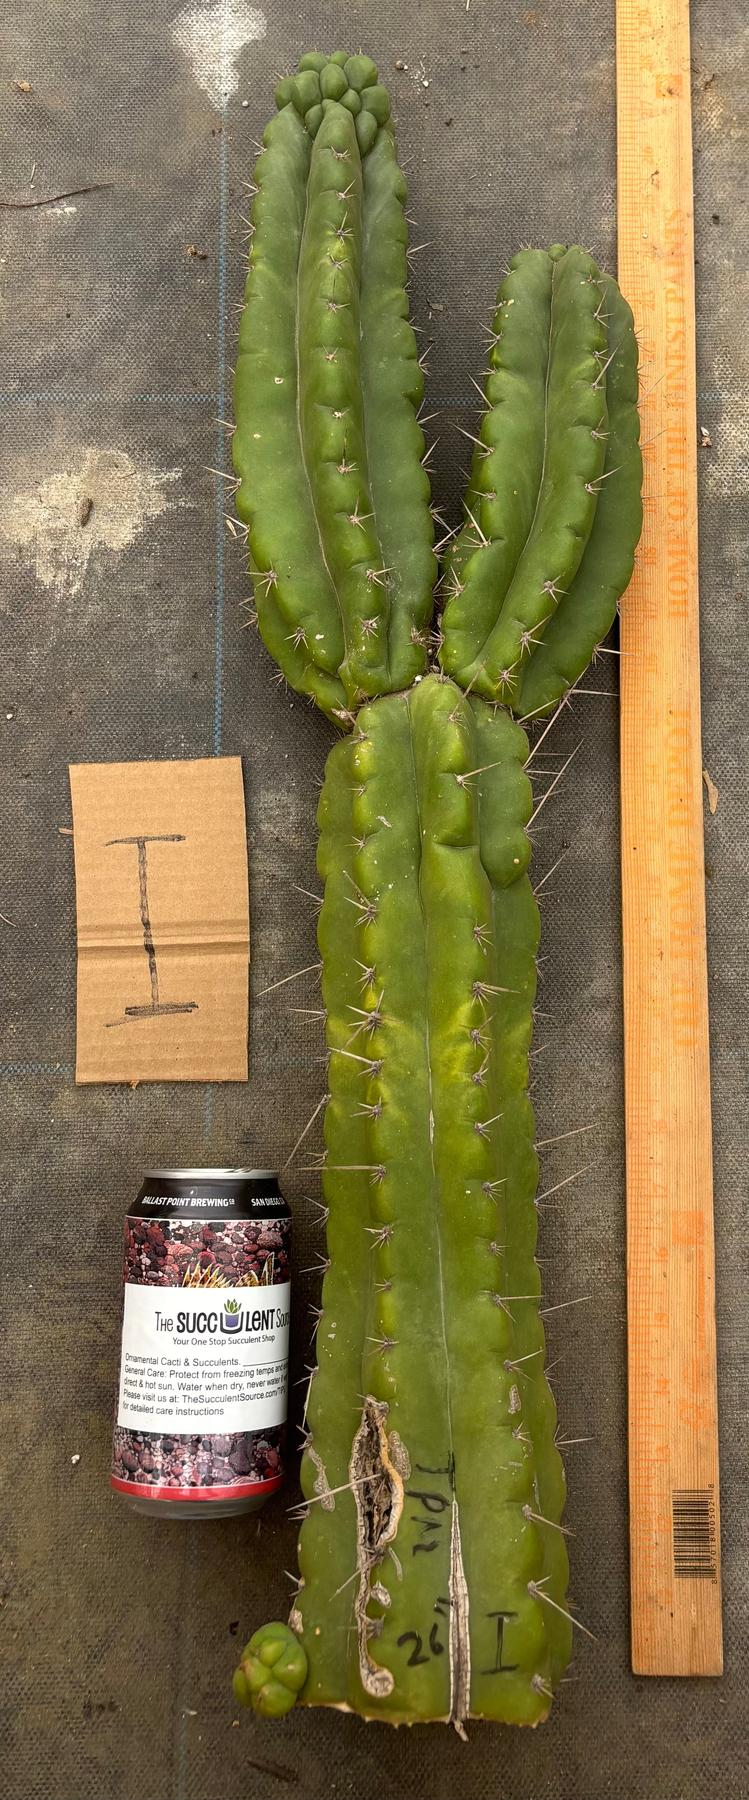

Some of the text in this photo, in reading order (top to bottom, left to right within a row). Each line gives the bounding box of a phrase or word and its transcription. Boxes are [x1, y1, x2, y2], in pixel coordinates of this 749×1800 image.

[663, 208, 686, 304] PAINTS
[666, 483, 688, 522] OF
[667, 531, 689, 618] HOME
[668, 840, 697, 960] HOME
[142, 1196, 168, 1205] BALLAST
[167, 1197, 191, 1206] POINT
[190, 1198, 229, 1207] BREWING
[250, 1197, 265, 1207] SAN
[265, 1197, 280, 1206] DIEGO
[172, 1337, 189, 1345] Your
[209, 1338, 227, 1346] Stop
[228, 1336, 261, 1345] Succulent
[262, 1335, 276, 1343] Shop
[125, 1352, 241, 1366] Ornamental Cacti & Succulents.
[125, 1364, 145, 1376] General
[147, 1368, 167, 1378] Care:
[169, 1369, 199, 1379] Protect
[201, 1370, 221, 1378] from
[223, 1369, 254, 1378] freezing
[256, 1366, 274, 1376] temps
[124, 1377, 137, 1387] direct
[139, 1379, 143, 1388] &
[145, 1381, 156, 1389] hot
[158, 1383, 175, 1391] sun.
[177, 1382, 202, 1391] Water
[205, 1382, 228, 1391] when
[230, 1382, 245, 1392] dry,
[246, 1379, 266, 1389] never
[267, 1376, 280, 1386] water
[123, 1388, 141, 1400] Please
[142, 1392, 156, 1401] visit
[169, 1395, 180, 1403] at:
[130, 1403, 154, 1414] detailed
[155, 1407, 173, 1415] care
[175, 1407, 224, 1416] instructions
[481, 1611, 519, 1675] I
